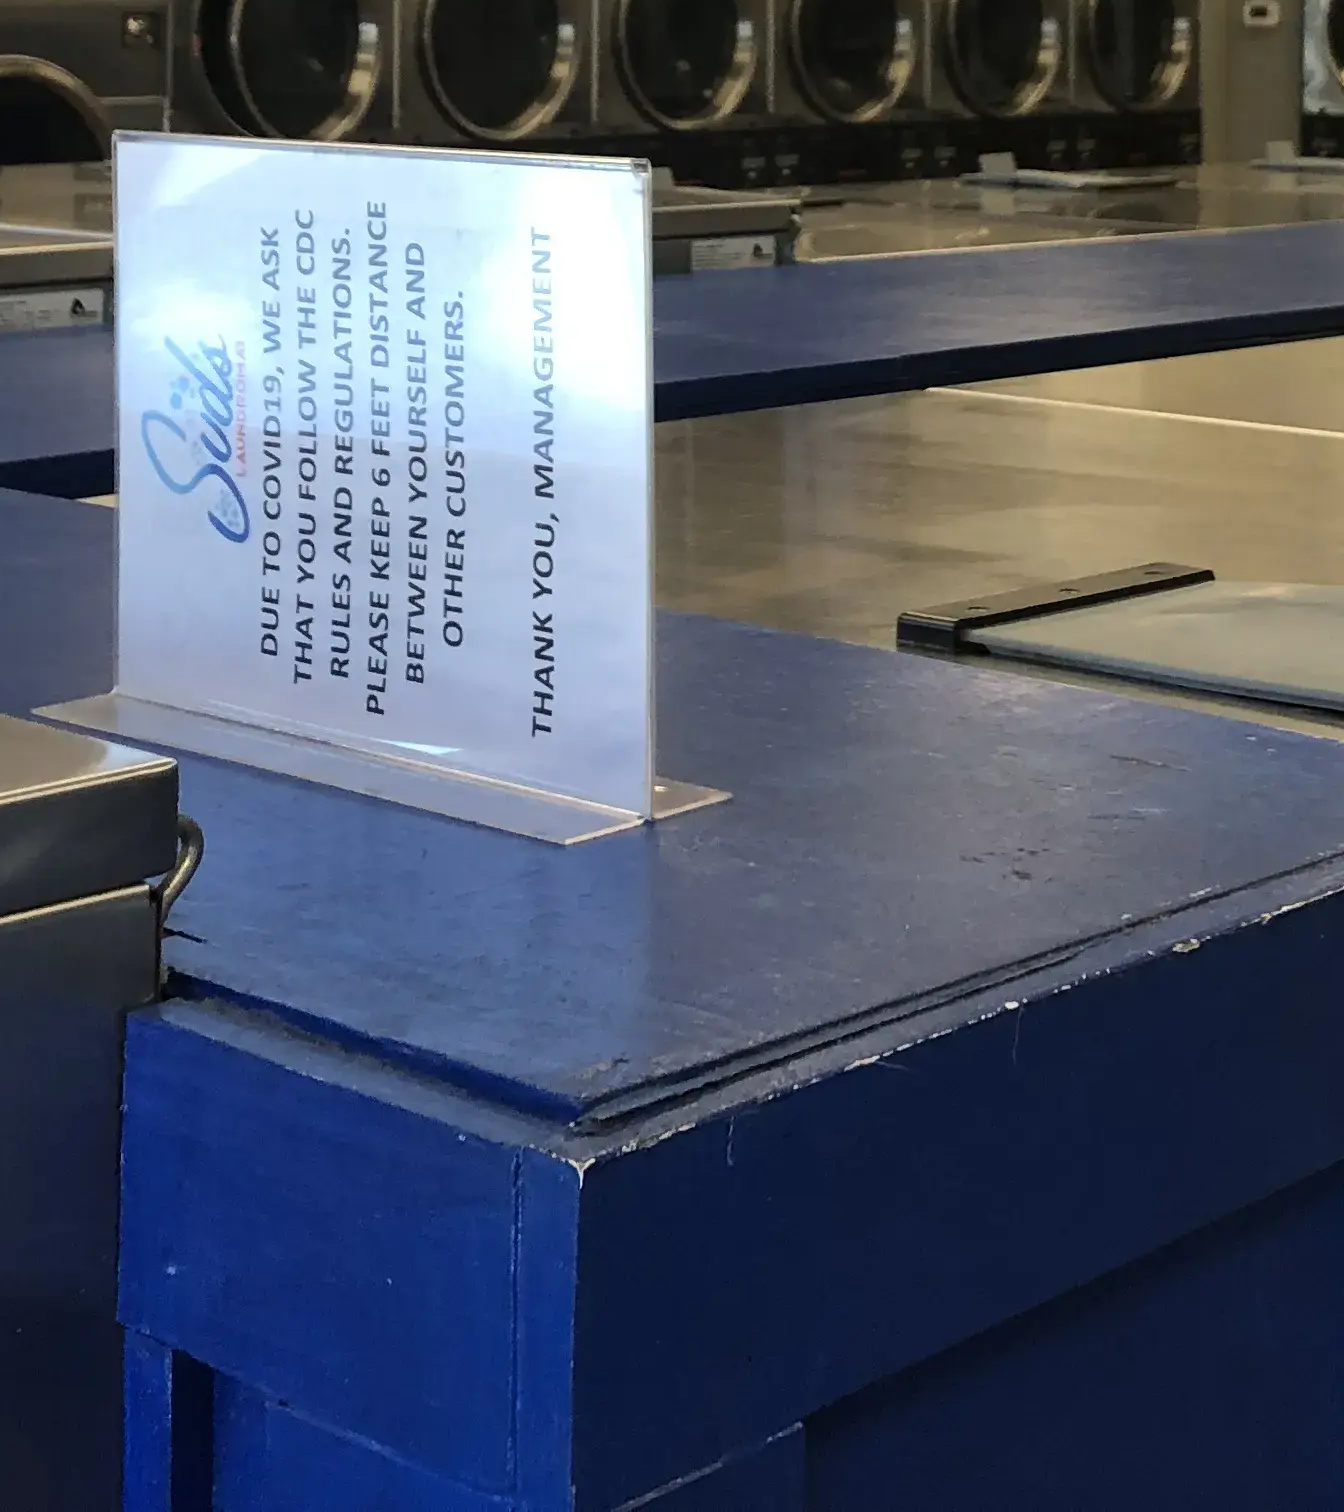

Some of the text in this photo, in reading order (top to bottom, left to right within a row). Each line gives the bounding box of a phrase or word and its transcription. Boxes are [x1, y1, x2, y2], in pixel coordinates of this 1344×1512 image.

[141, 335, 251, 543] Suds
[261, 227, 285, 657] DUE TO COVID19, WE ASK
[294, 209, 317, 684] THAT YOU FOLLOW THE CDC
[331, 228, 354, 679] RULES AND REGULATIONS.
[366, 201, 391, 715] PLEASE KEEP 6 FEET DISTANCE
[405, 242, 428, 684] BETWEEN YOURSELF AND
[443, 290, 466, 648] OTHER CUSTOMERS.
[531, 227, 559, 737] THANK YOU, MANAGEMENT
